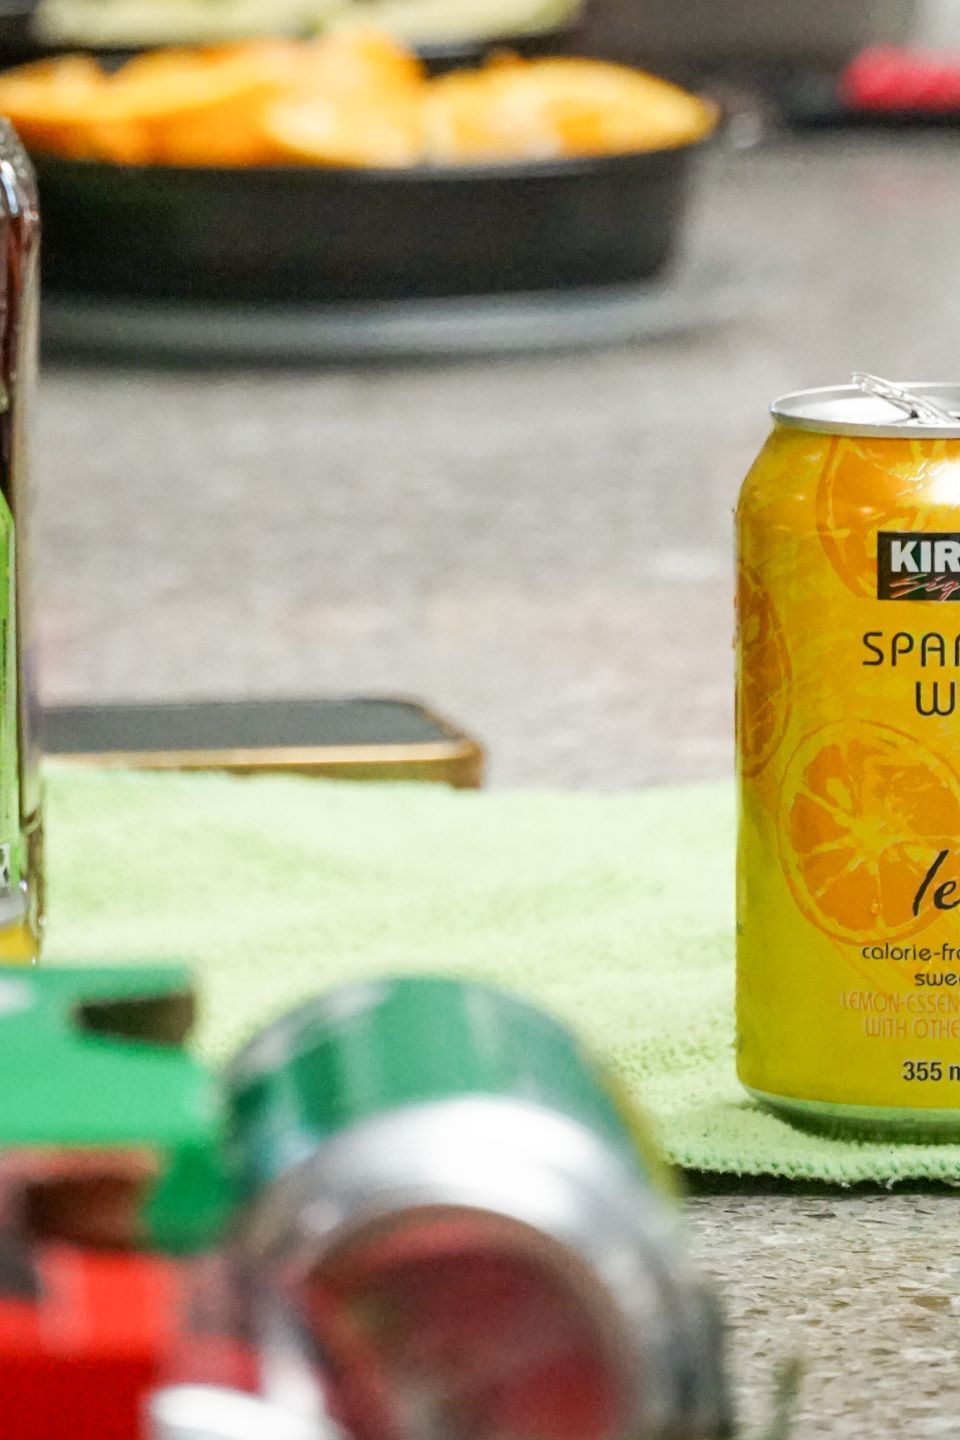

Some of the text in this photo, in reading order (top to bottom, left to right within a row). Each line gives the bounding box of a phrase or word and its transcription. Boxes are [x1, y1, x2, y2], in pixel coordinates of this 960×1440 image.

[862, 631, 960, 667] SPA
[914, 972, 960, 987] swe
[864, 1017, 907, 1038] WITH
[903, 1061, 942, 1081] 355
